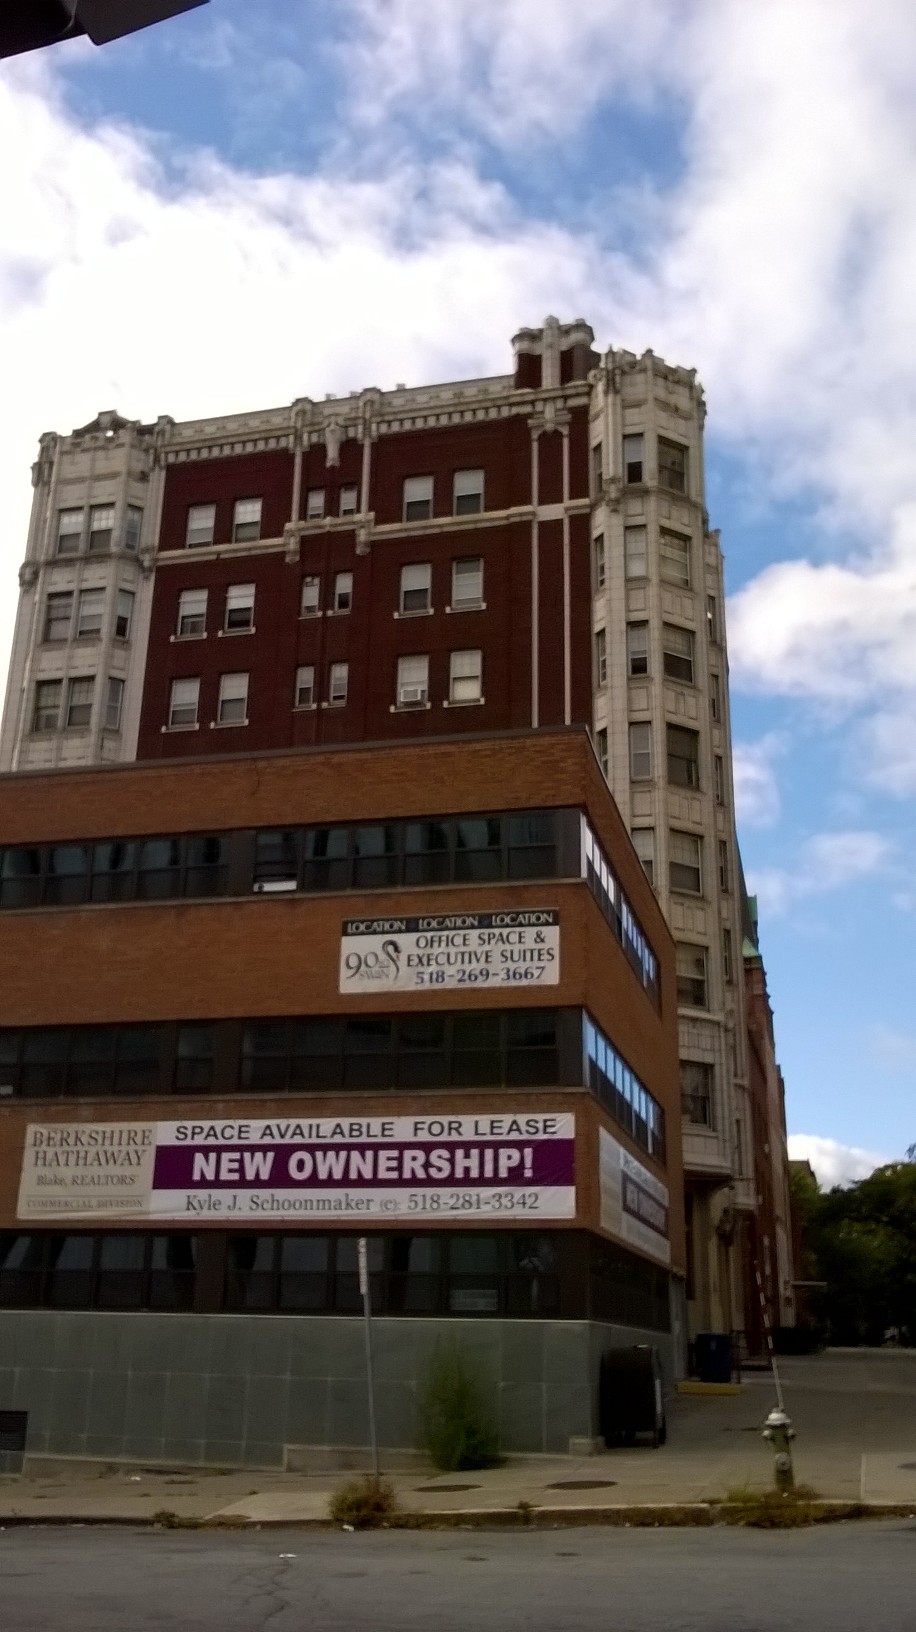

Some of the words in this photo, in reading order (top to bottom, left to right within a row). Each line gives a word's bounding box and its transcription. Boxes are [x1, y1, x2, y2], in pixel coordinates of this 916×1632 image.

[347, 920, 407, 933] LOCATION
[418, 917, 479, 930] LOCATION
[491, 913, 554, 926] LOCATION
[415, 934, 471, 949] OFFICE
[477, 930, 526, 946] SPACE
[533, 930, 546, 944] &
[406, 950, 493, 968] EXECUTIVE
[500, 947, 555, 963] SUITES
[414, 966, 546, 985] 518-269-3667
[31, 1128, 153, 1148] BERKSHIRE
[174, 1124, 250, 1141] SPACE
[259, 1121, 395, 1140] AVAILABLE
[412, 1119, 464, 1137] FOR
[473, 1118, 559, 1136] LEASE
[33, 1149, 147, 1168] HATHAWAY
[192, 1151, 275, 1181] NEW
[287, 1147, 534, 1181] OWNERSHIP!
[185, 1194, 222, 1216] Kyle
[227, 1194, 243, 1211] J.
[249, 1192, 375, 1211] Schoonmaker
[407, 1191, 540, 1211] 518-281-3342
